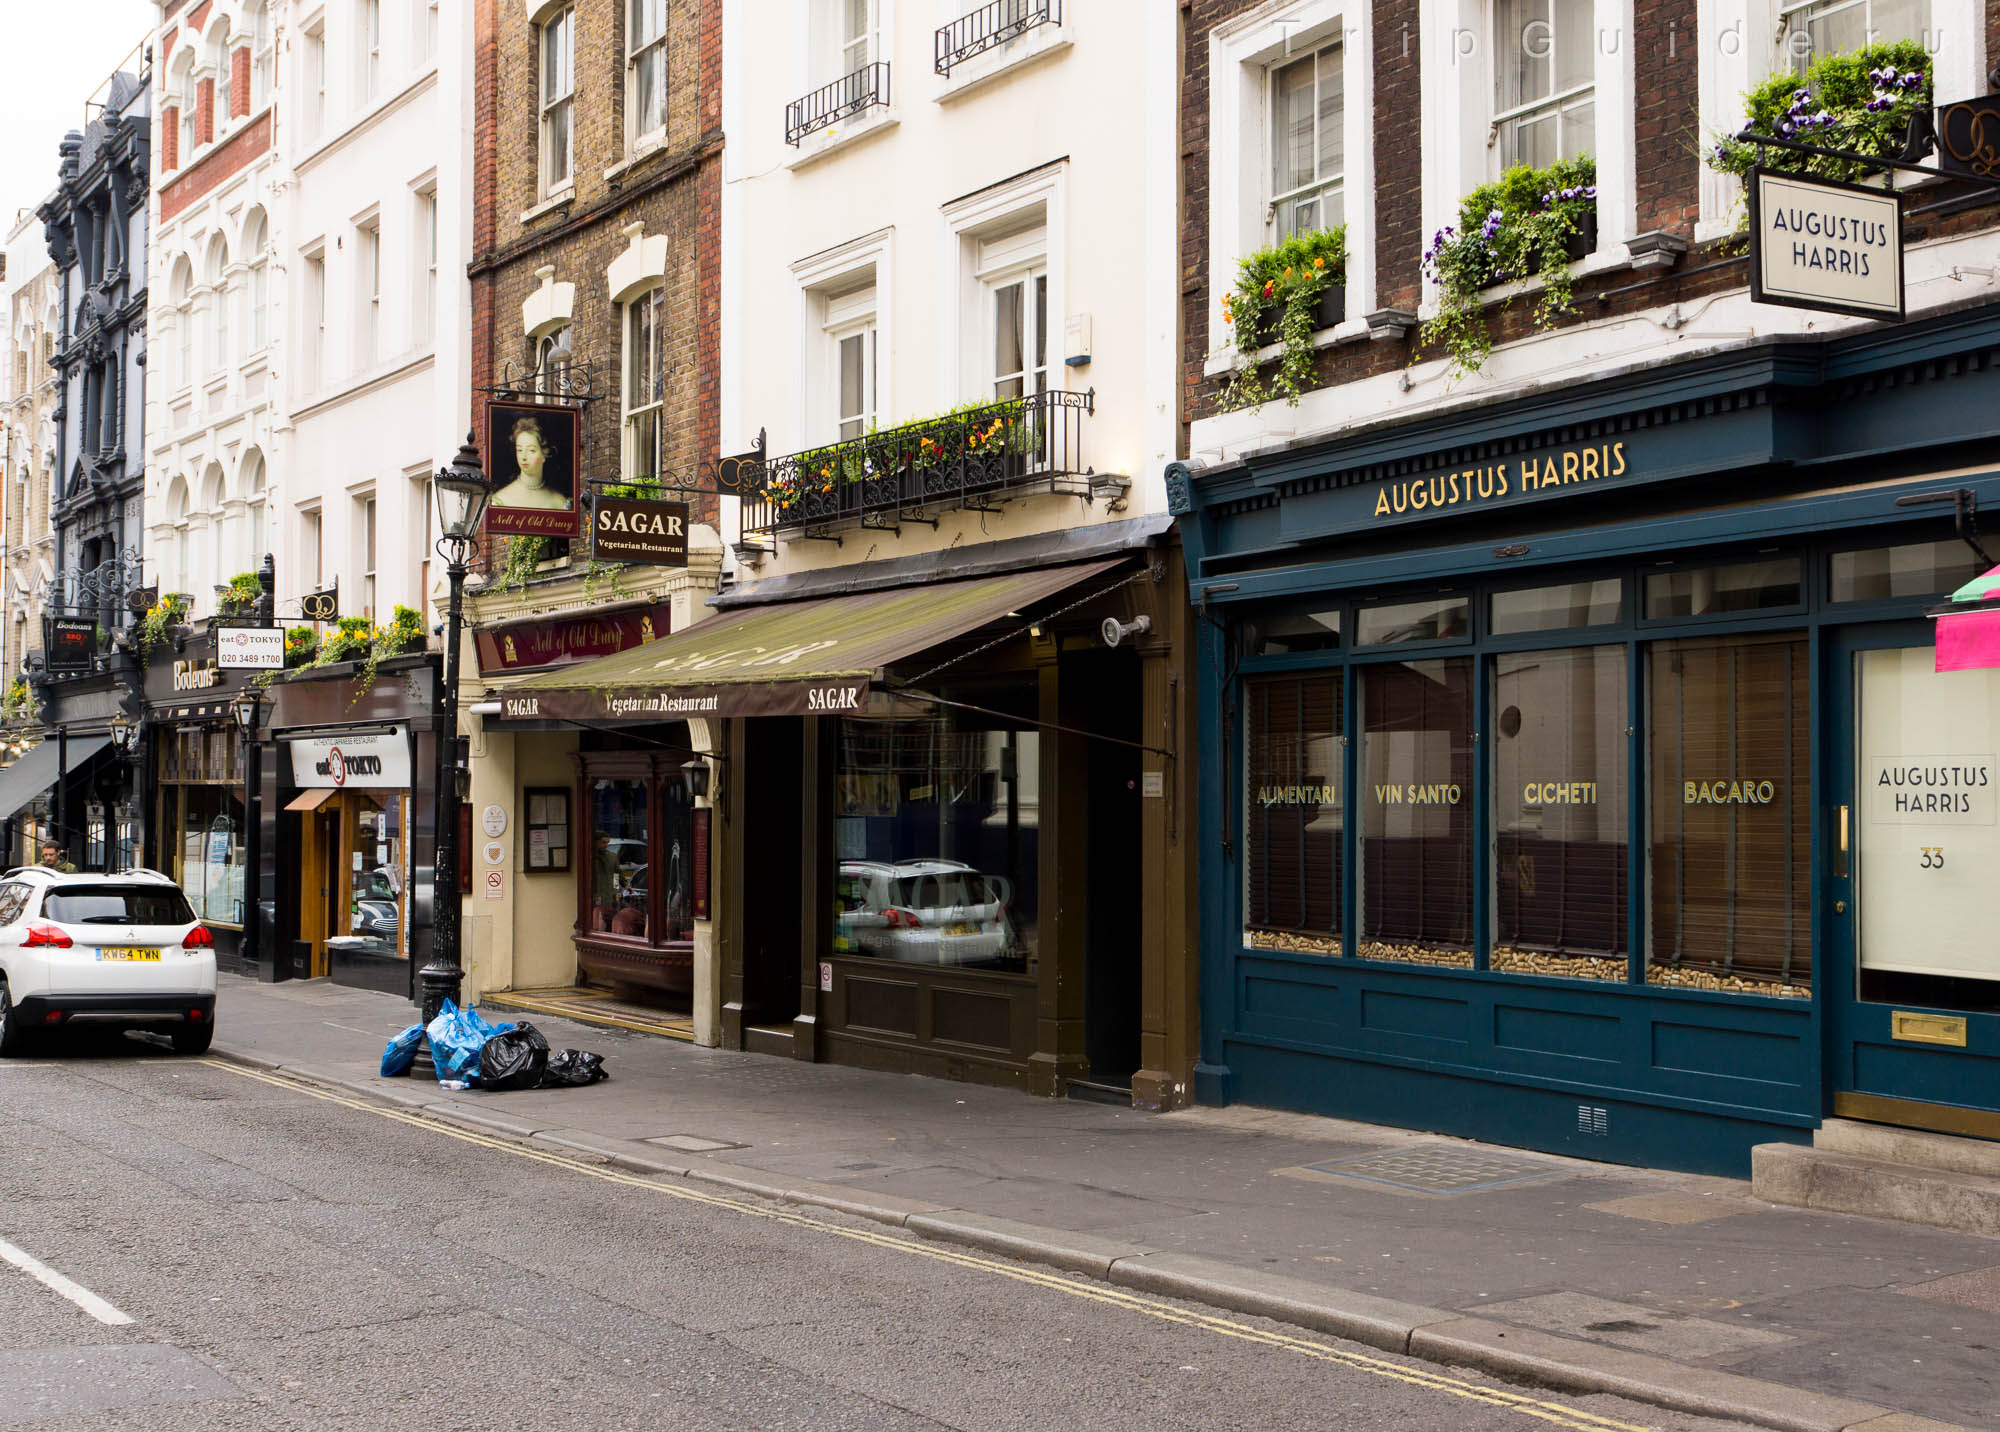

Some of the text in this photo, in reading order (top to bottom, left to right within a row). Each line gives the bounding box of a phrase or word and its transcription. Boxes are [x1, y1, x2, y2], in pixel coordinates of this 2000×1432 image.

[1773, 208, 1887, 247] AUGUSTUS
[1793, 241, 1870, 276] HARRIS
[1374, 442, 1627, 517] AUGUSTUS HARRIS
[491, 514, 513, 525] Nell
[516, 514, 524, 529] of
[527, 514, 544, 527] Old
[598, 510, 684, 537] SAGAR
[598, 539, 684, 553] Vegetarian Restaurant
[249, 636, 281, 644] TOKYO
[569, 623, 586, 648] Old
[221, 654, 281, 663] 020 3489 1700
[507, 687, 859, 717] SAGAR Vegetarian Restaurant SAGAR
[316, 755, 381, 775] eat TOKYO
[1878, 767, 1988, 786] AUGUSTUS
[1257, 780, 1774, 805] ALIMENTARI VIN SANTO CICHETI BACARO
[1895, 793, 1970, 813] HARRIS
[1920, 847, 1944, 869] 33
[103, 949, 159, 960] KW64 TWN
